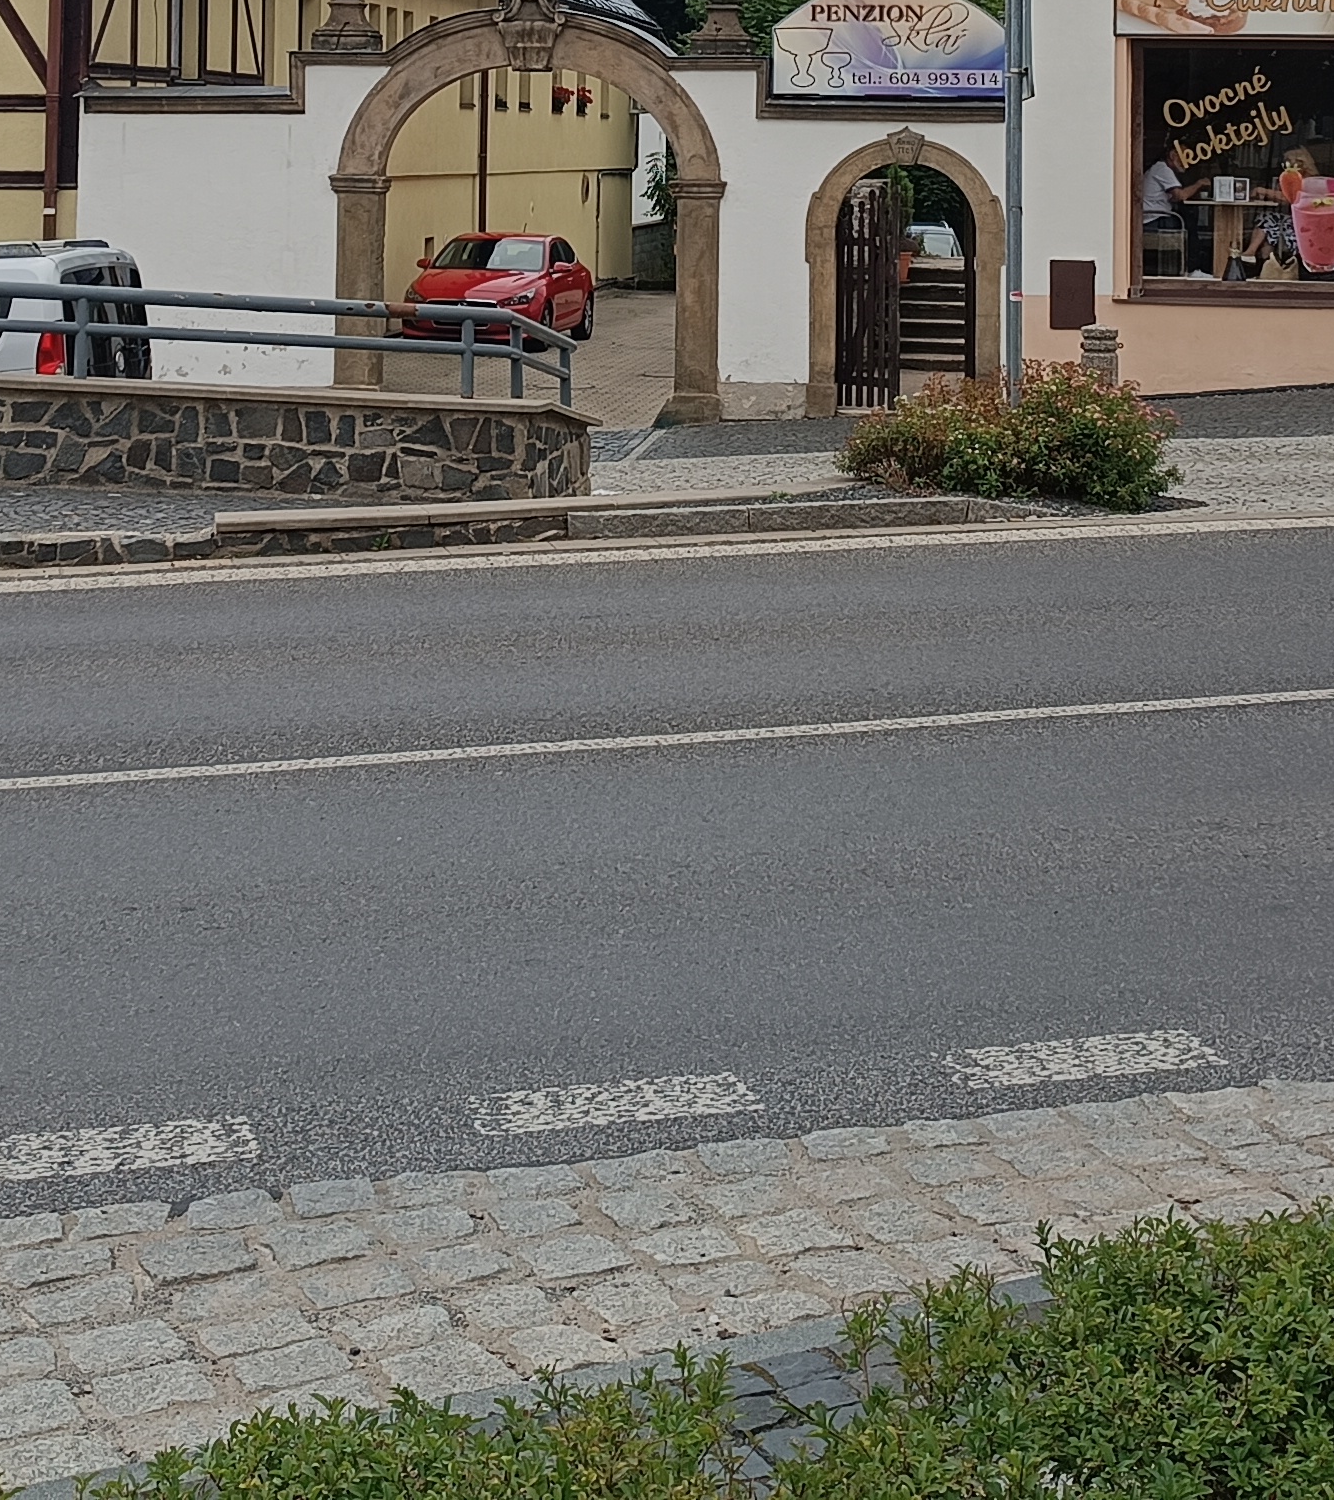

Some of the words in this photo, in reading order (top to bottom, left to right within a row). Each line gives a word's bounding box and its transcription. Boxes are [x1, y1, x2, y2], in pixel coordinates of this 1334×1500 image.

[810, 4, 924, 23] PENZION
[852, 72, 882, 85] tel.:
[889, 71, 921, 85] 604
[927, 72, 961, 86] 993
[966, 72, 1000, 86] 614
[1163, 67, 1271, 127] Ovocné
[1173, 102, 1293, 169] koktejly
